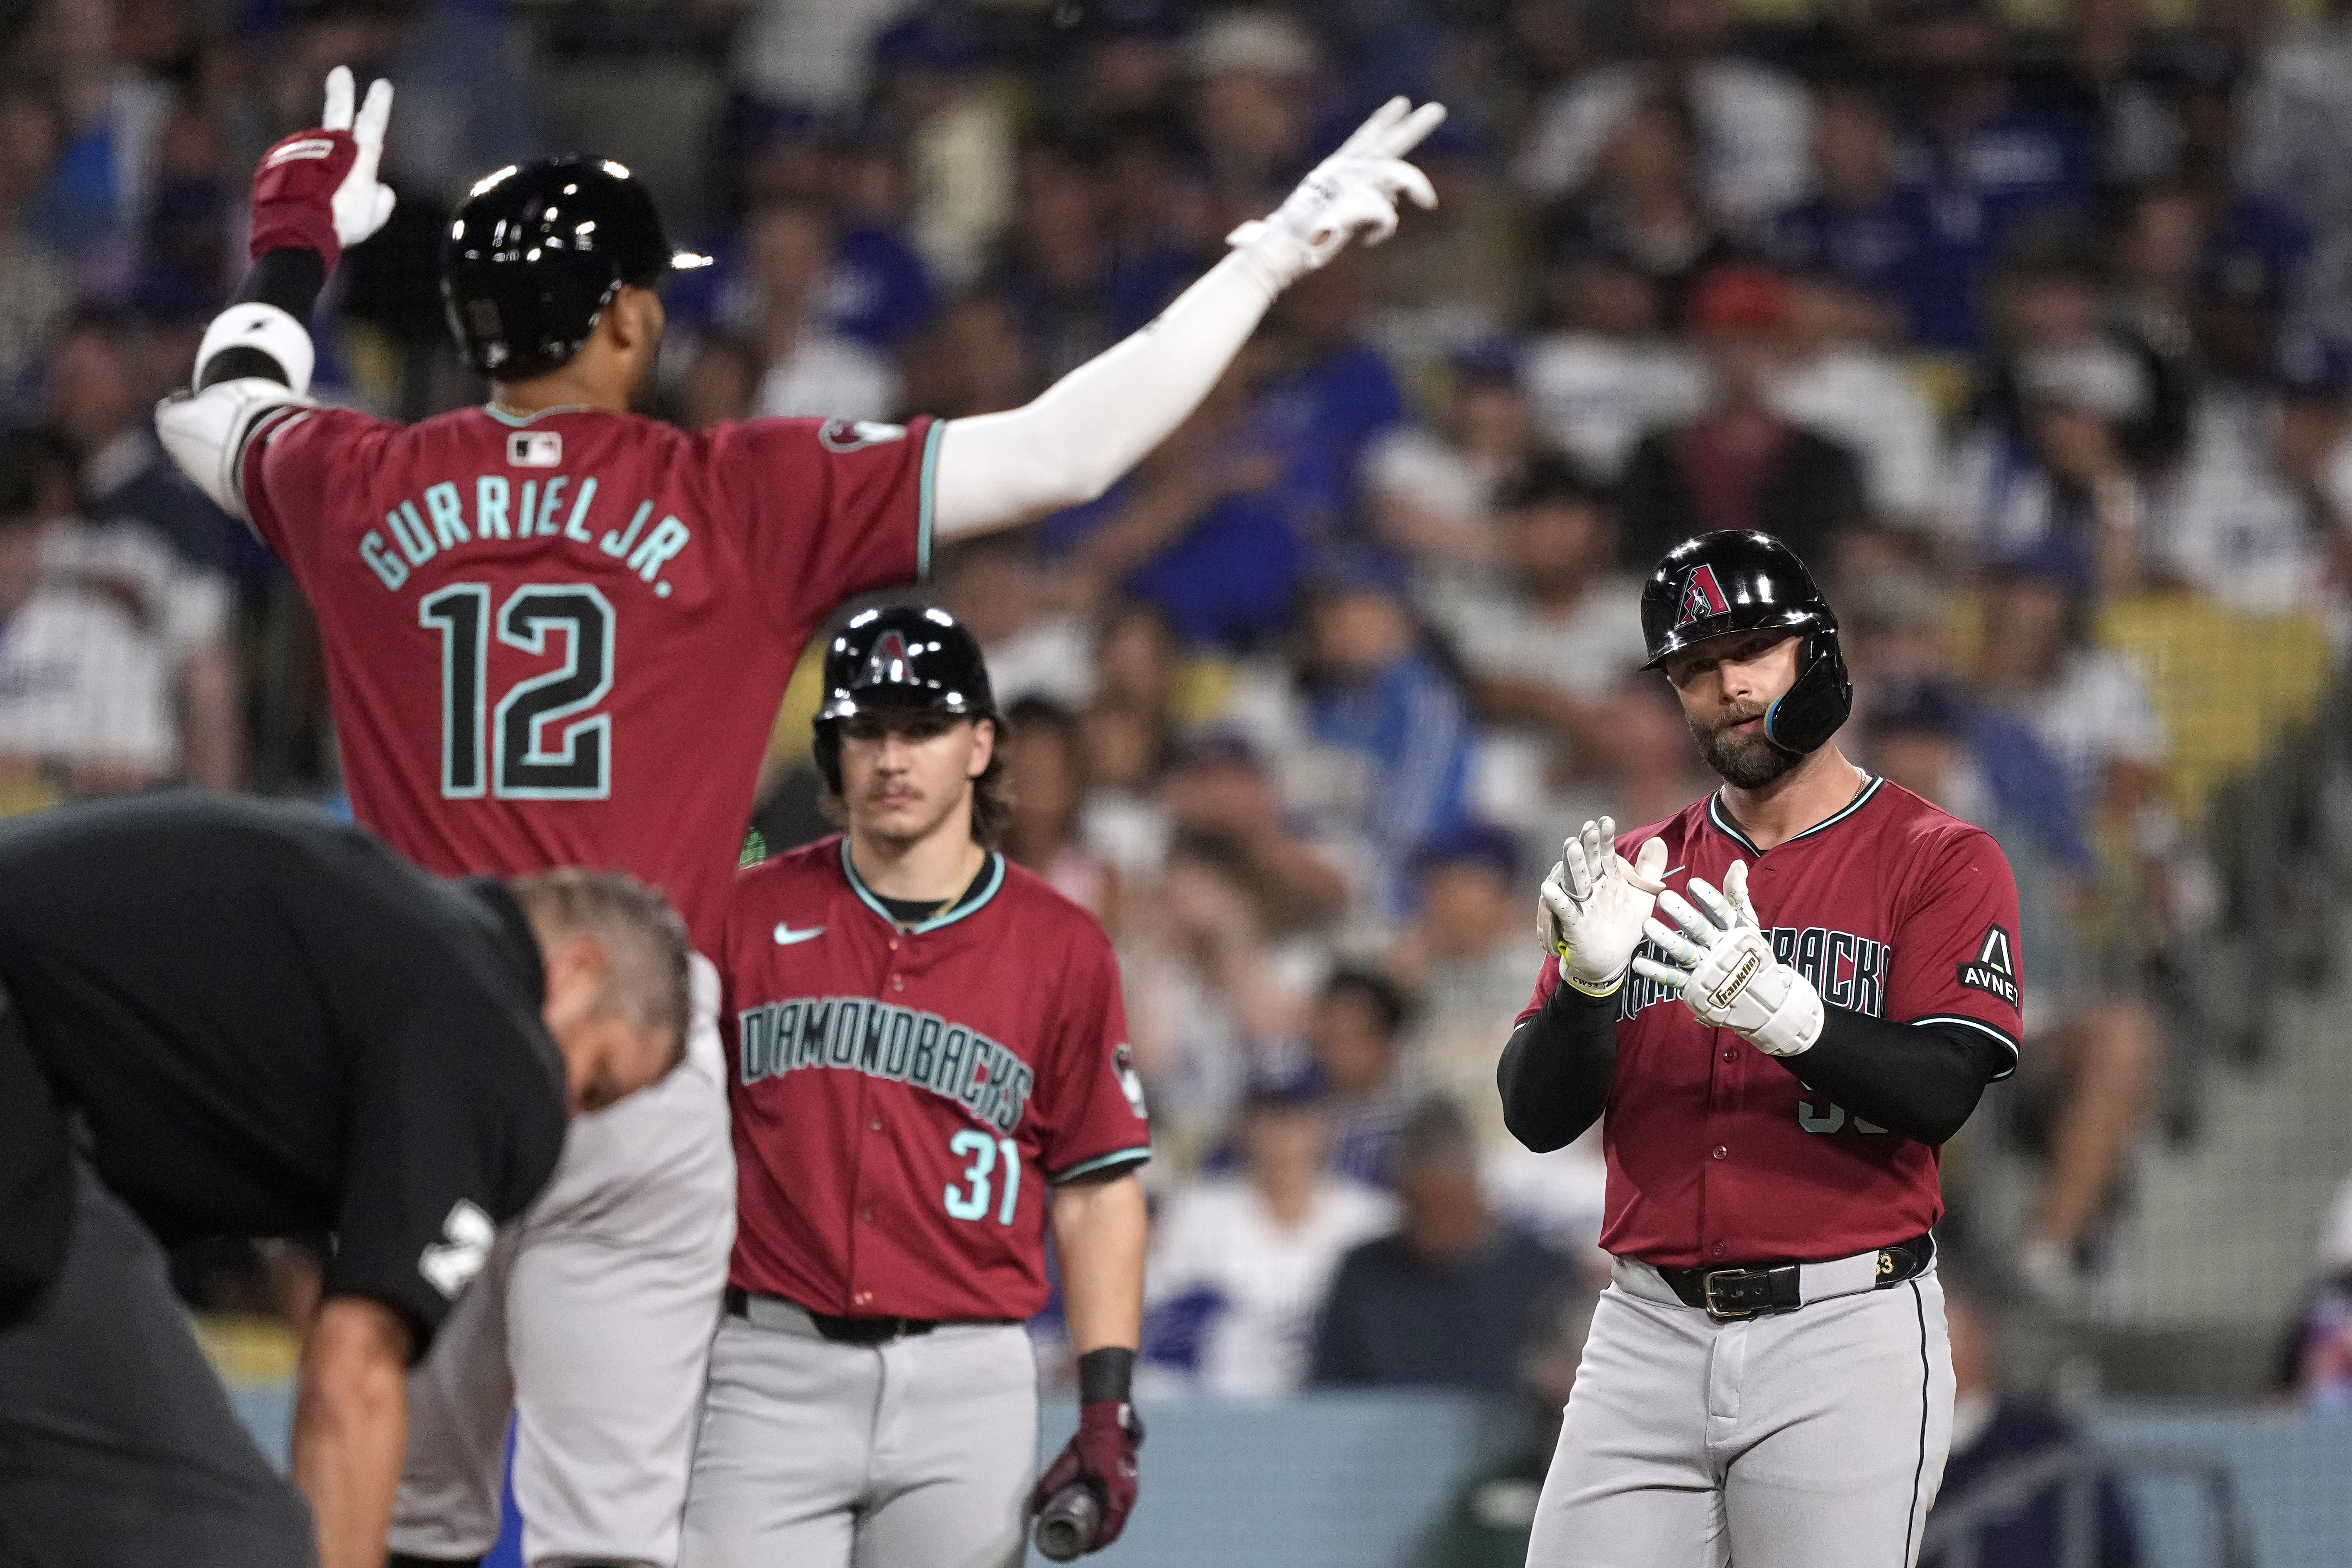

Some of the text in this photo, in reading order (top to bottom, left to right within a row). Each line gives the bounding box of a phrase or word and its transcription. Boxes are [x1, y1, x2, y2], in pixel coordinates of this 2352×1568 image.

[360, 475, 690, 598] GURRIEL JR.
[419, 582, 616, 800] 12
[738, 996, 1034, 1135] DIAMONDBACKS
[944, 1129, 1021, 1226] 31
